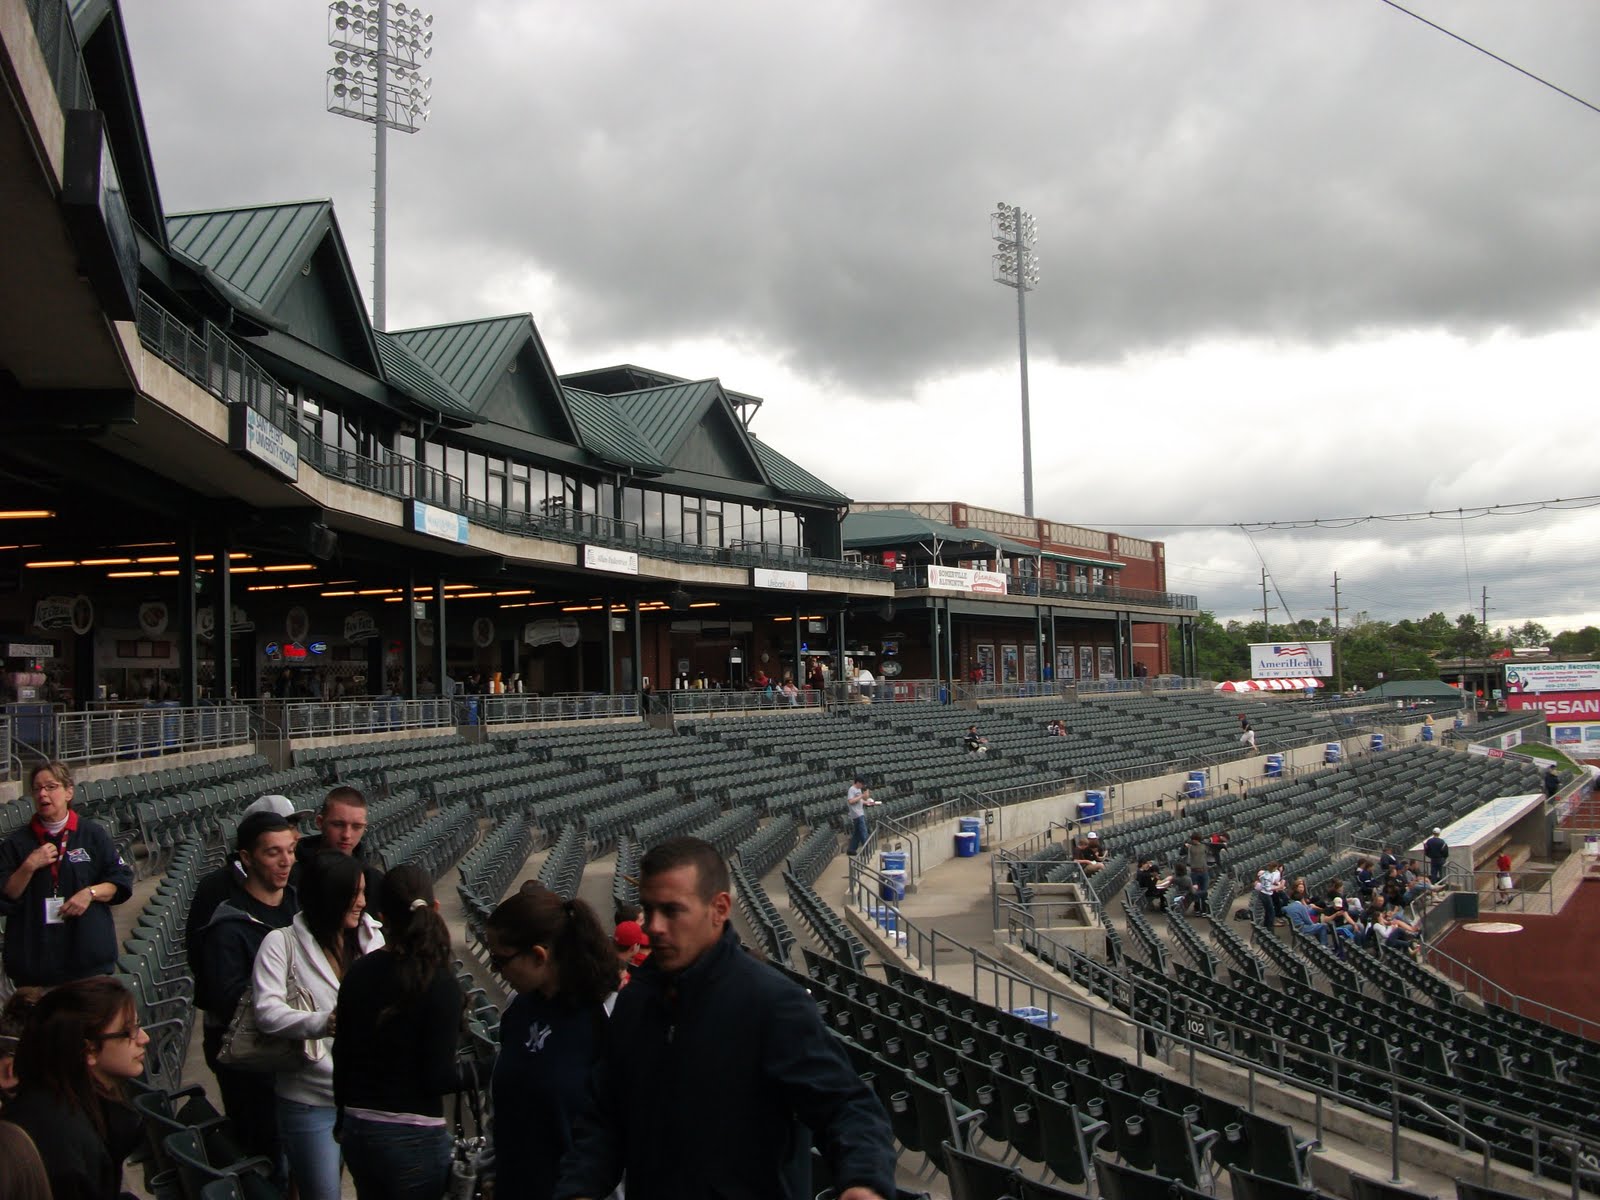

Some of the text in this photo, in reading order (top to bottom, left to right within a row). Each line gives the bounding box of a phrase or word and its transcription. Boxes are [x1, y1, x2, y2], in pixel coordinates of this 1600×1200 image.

[255, 429, 279, 458] UNIVERSITY
[279, 449, 297, 470] HOSPITAL
[939, 569, 968, 580] SOMERVILLE
[1258, 658, 1323, 669] AmeriHealth
[1507, 663, 1600, 672] Somerset County Recycling
[1522, 699, 1600, 715] NISSAN
[1187, 1018, 1205, 1035] 102
